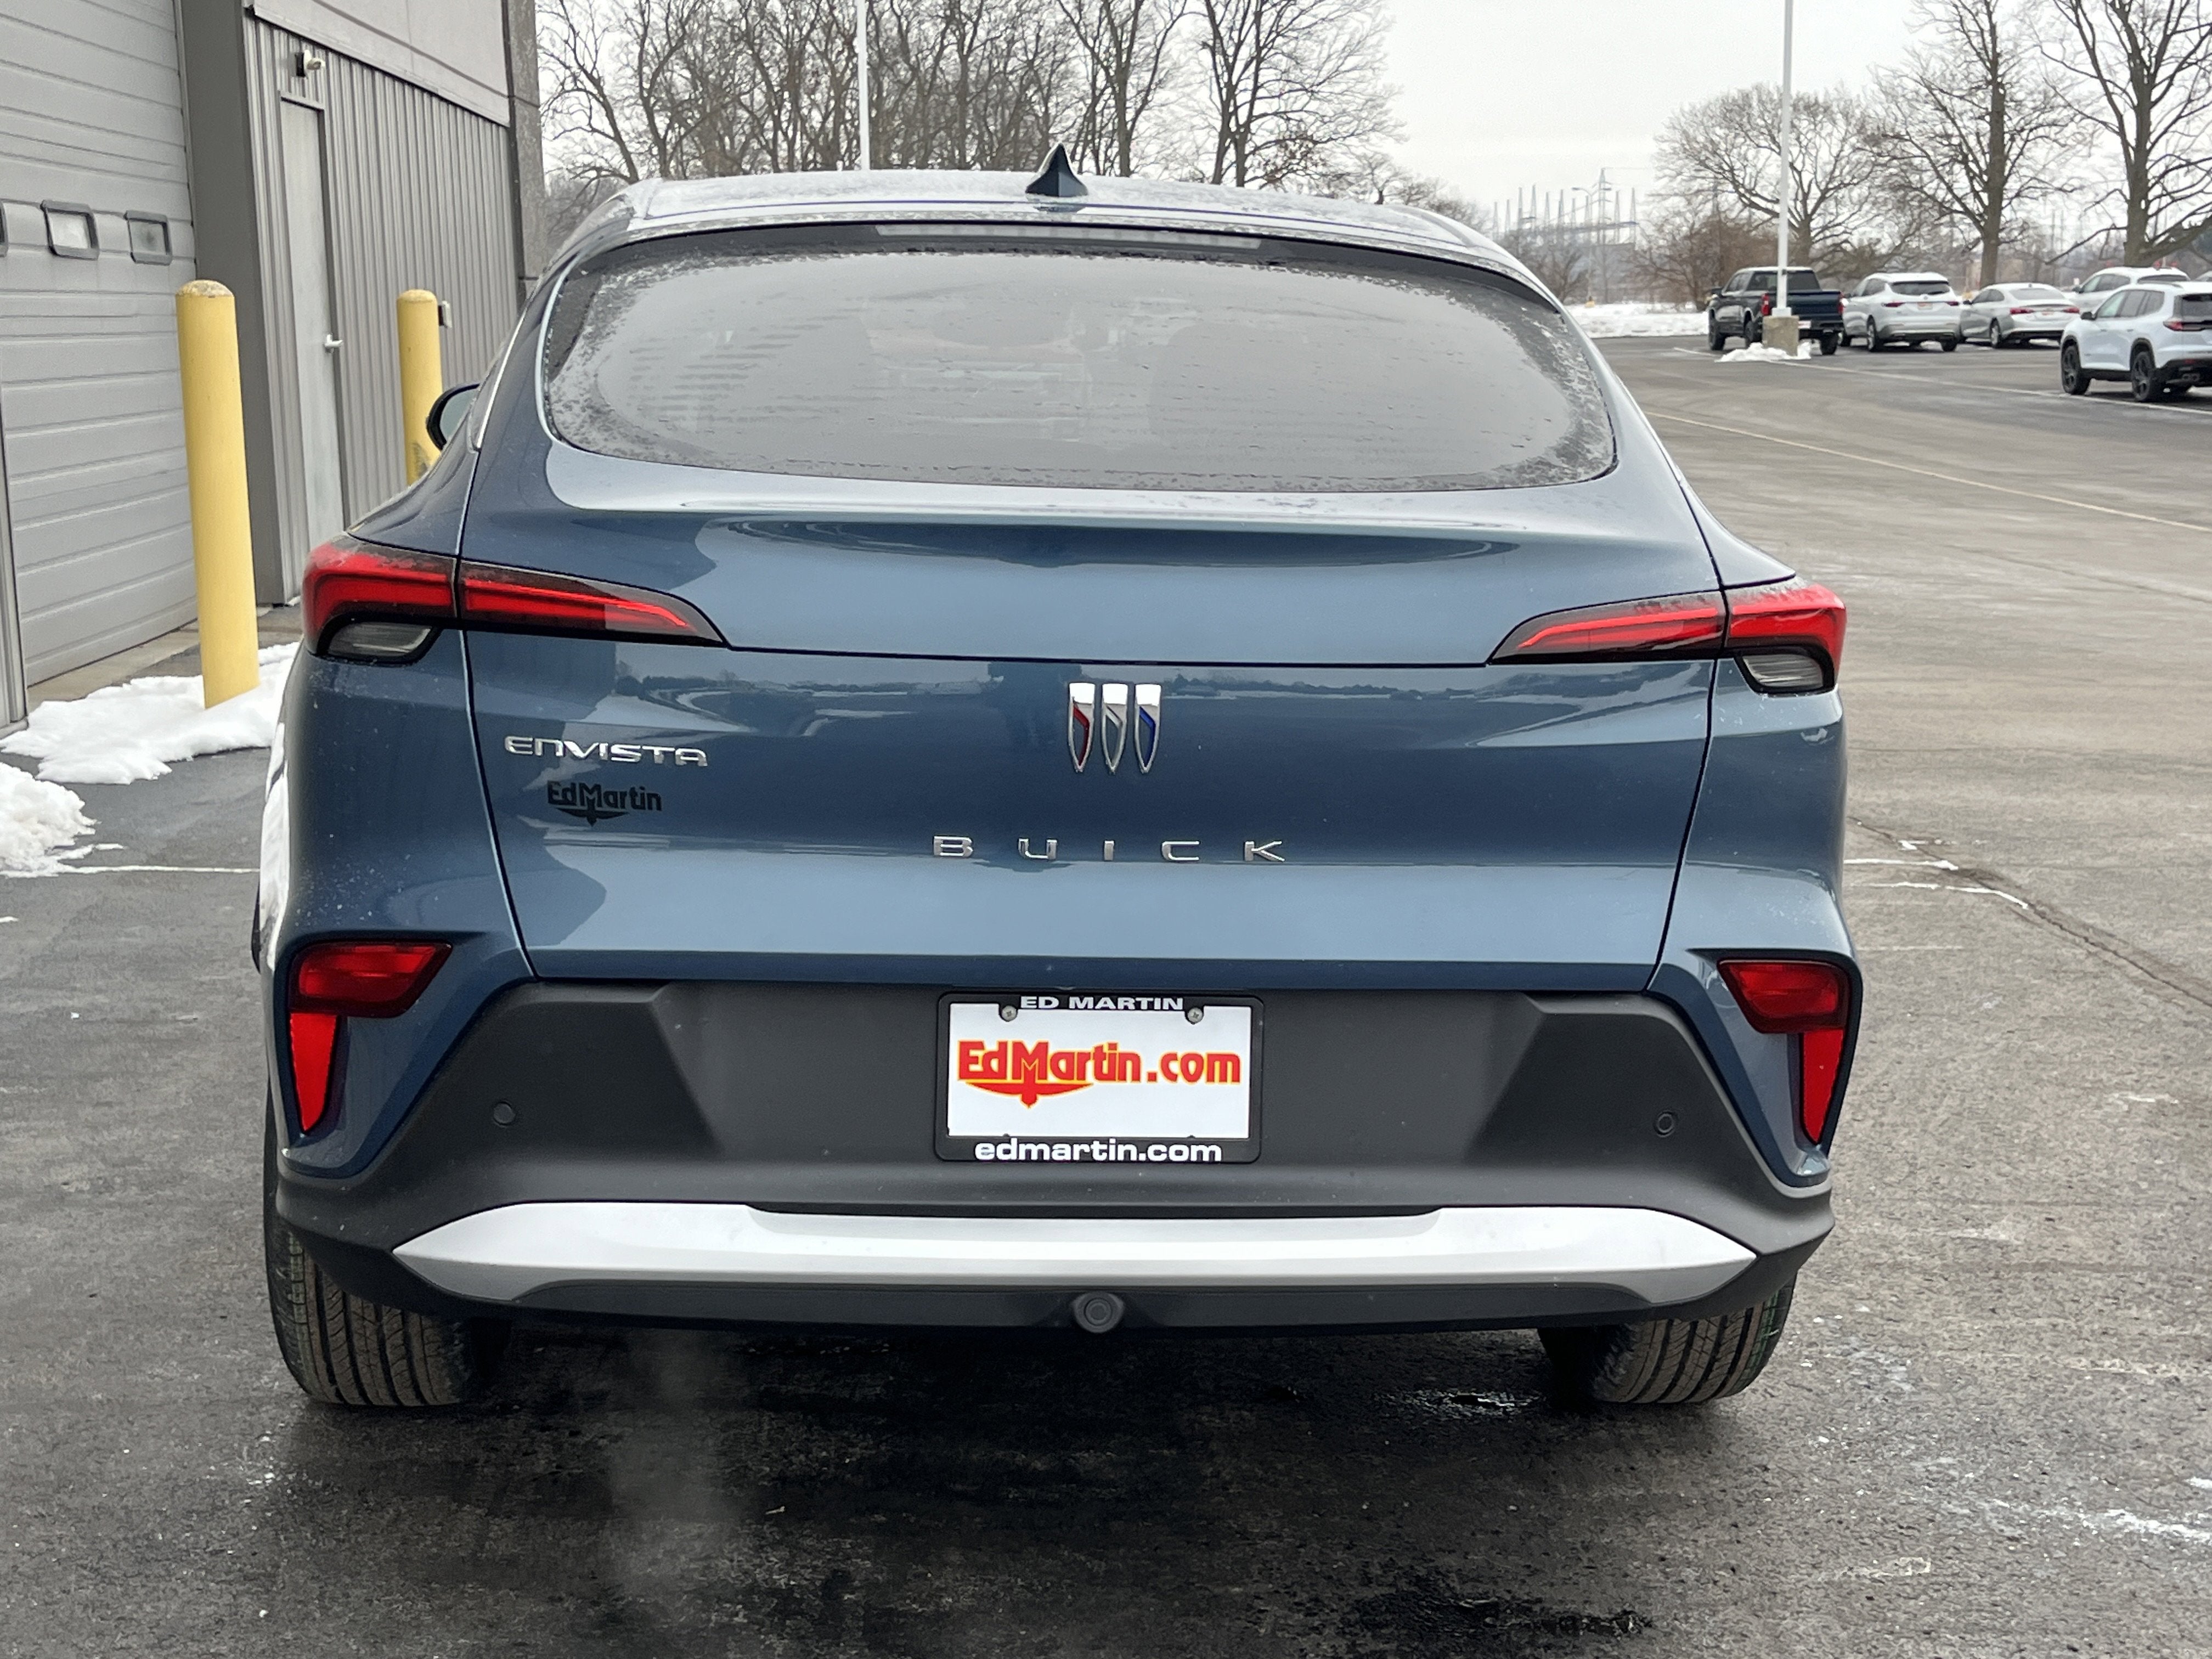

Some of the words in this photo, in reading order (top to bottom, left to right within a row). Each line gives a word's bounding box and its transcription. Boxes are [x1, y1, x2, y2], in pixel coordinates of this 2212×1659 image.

[504, 735, 709, 767] ENVISTA
[548, 780, 663, 812] EdMartin
[933, 834, 1285, 862] BUICK
[1020, 996, 1059, 1009] ED
[1069, 997, 1184, 1011] MARTIN
[957, 1040, 1241, 1084] EdMartin.com
[975, 1138, 1222, 1162] edmartin.com
